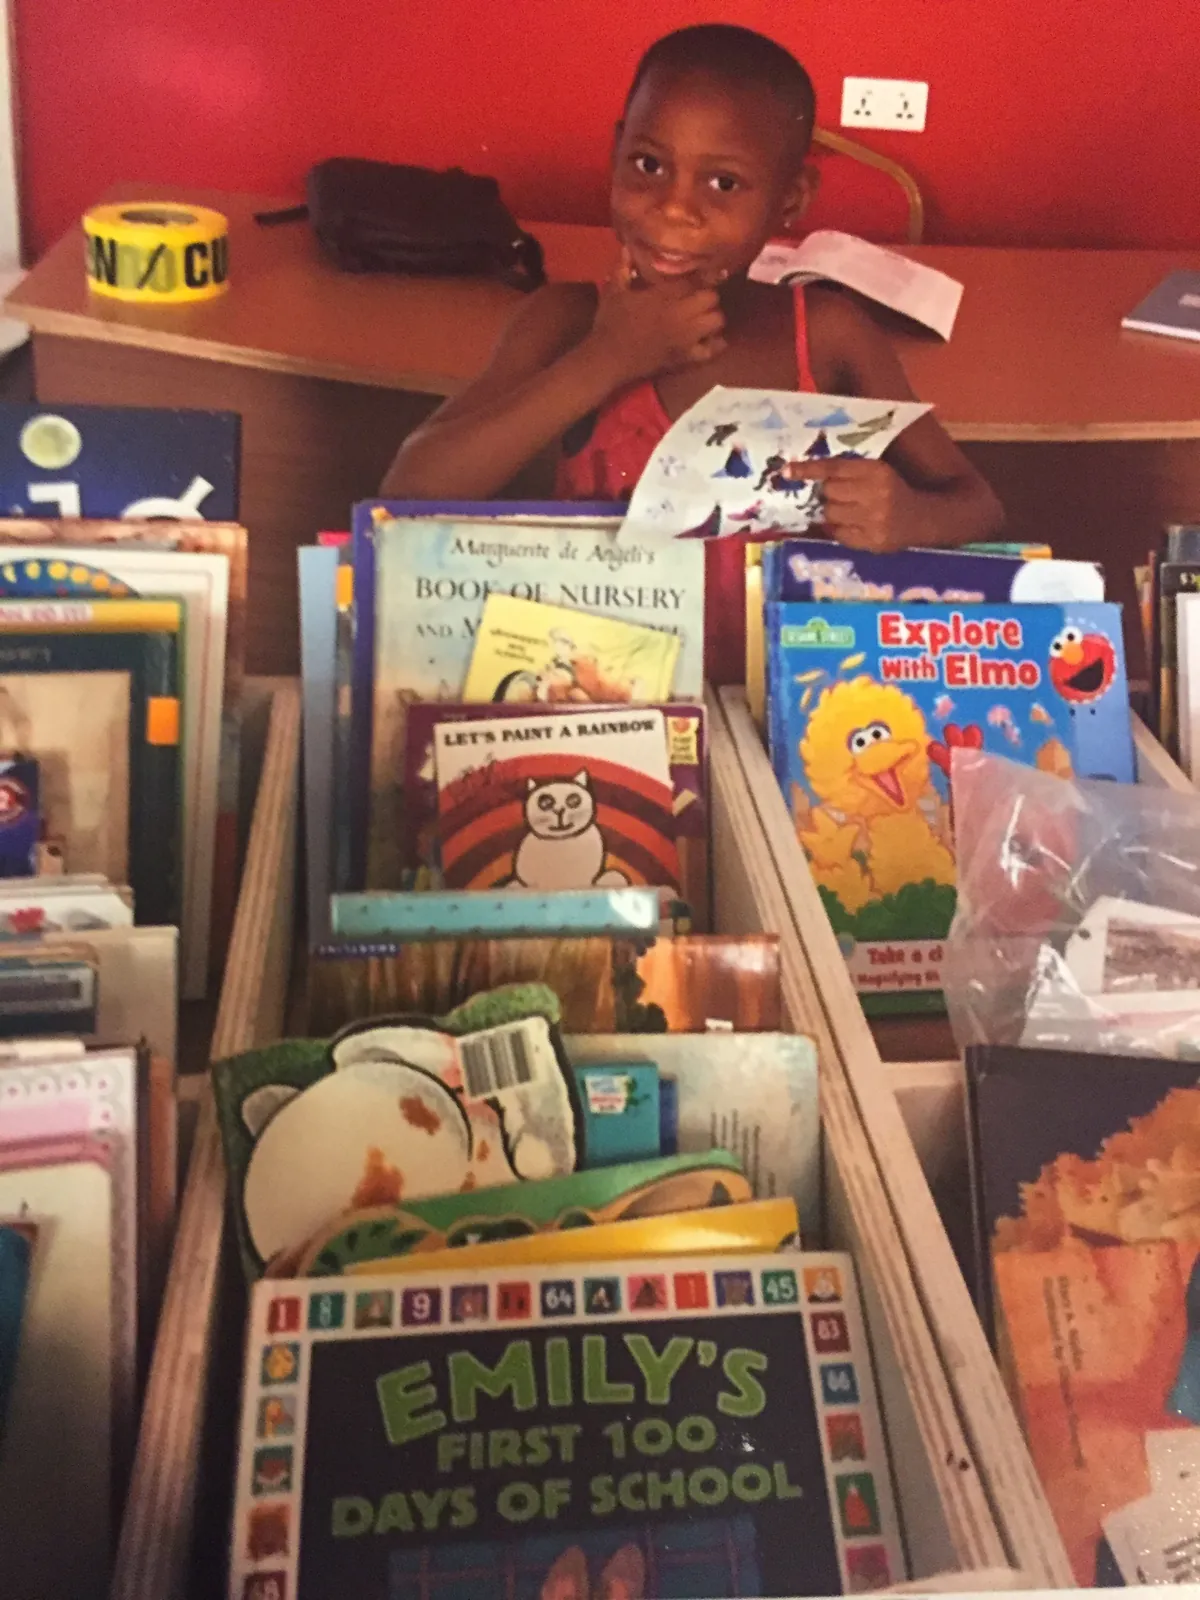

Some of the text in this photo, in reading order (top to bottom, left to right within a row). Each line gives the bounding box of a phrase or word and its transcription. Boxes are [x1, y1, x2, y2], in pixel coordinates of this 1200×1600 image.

[558, 541, 579, 560] de
[560, 584, 687, 610] NURSERY
[878, 612, 1022, 658] Explore
[944, 652, 1041, 690] Elmo
[444, 719, 655, 746] LET'S PAINT A RAINBOW
[545, 1287, 572, 1310] 64
[766, 1276, 794, 1300] 45
[411, 1293, 431, 1319] 9
[375, 1333, 769, 1446] EMILY'S
[436, 1415, 717, 1473] FIRST 100
[331, 1461, 803, 1537] DAYS OF SCHOOL
